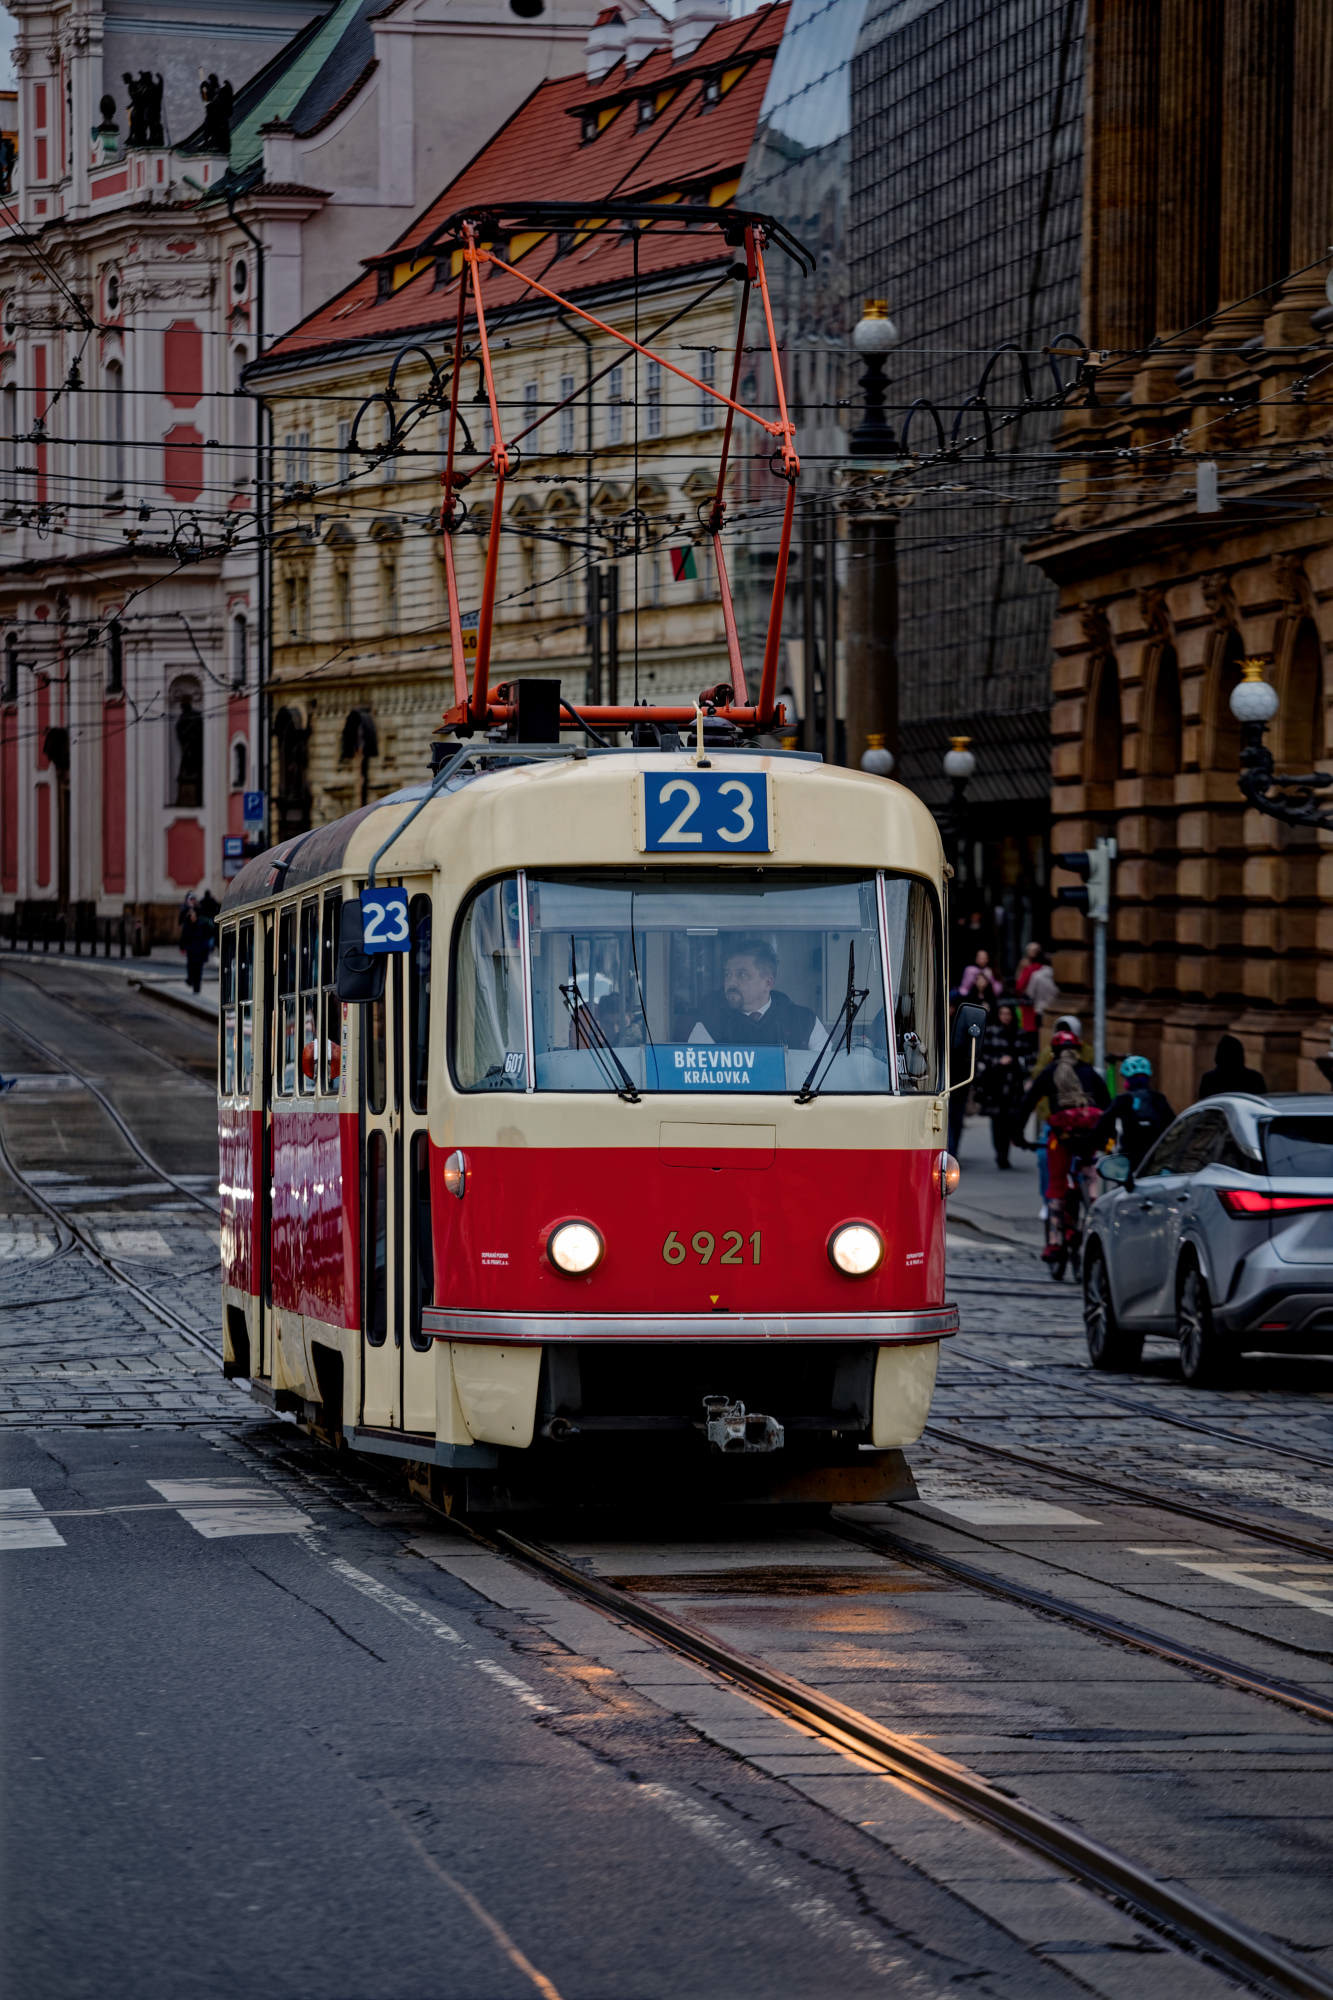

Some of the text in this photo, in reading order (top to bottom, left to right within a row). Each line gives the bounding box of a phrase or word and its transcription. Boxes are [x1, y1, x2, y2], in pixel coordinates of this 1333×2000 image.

[248, 794, 259, 810] P
[658, 779, 754, 843] 23
[362, 901, 409, 944] 23
[505, 1053, 524, 1073] 601
[674, 1047, 755, 1068] BŘEVNOV
[684, 1069, 751, 1084] KRÁLOVKA
[662, 1230, 761, 1265] 6921
